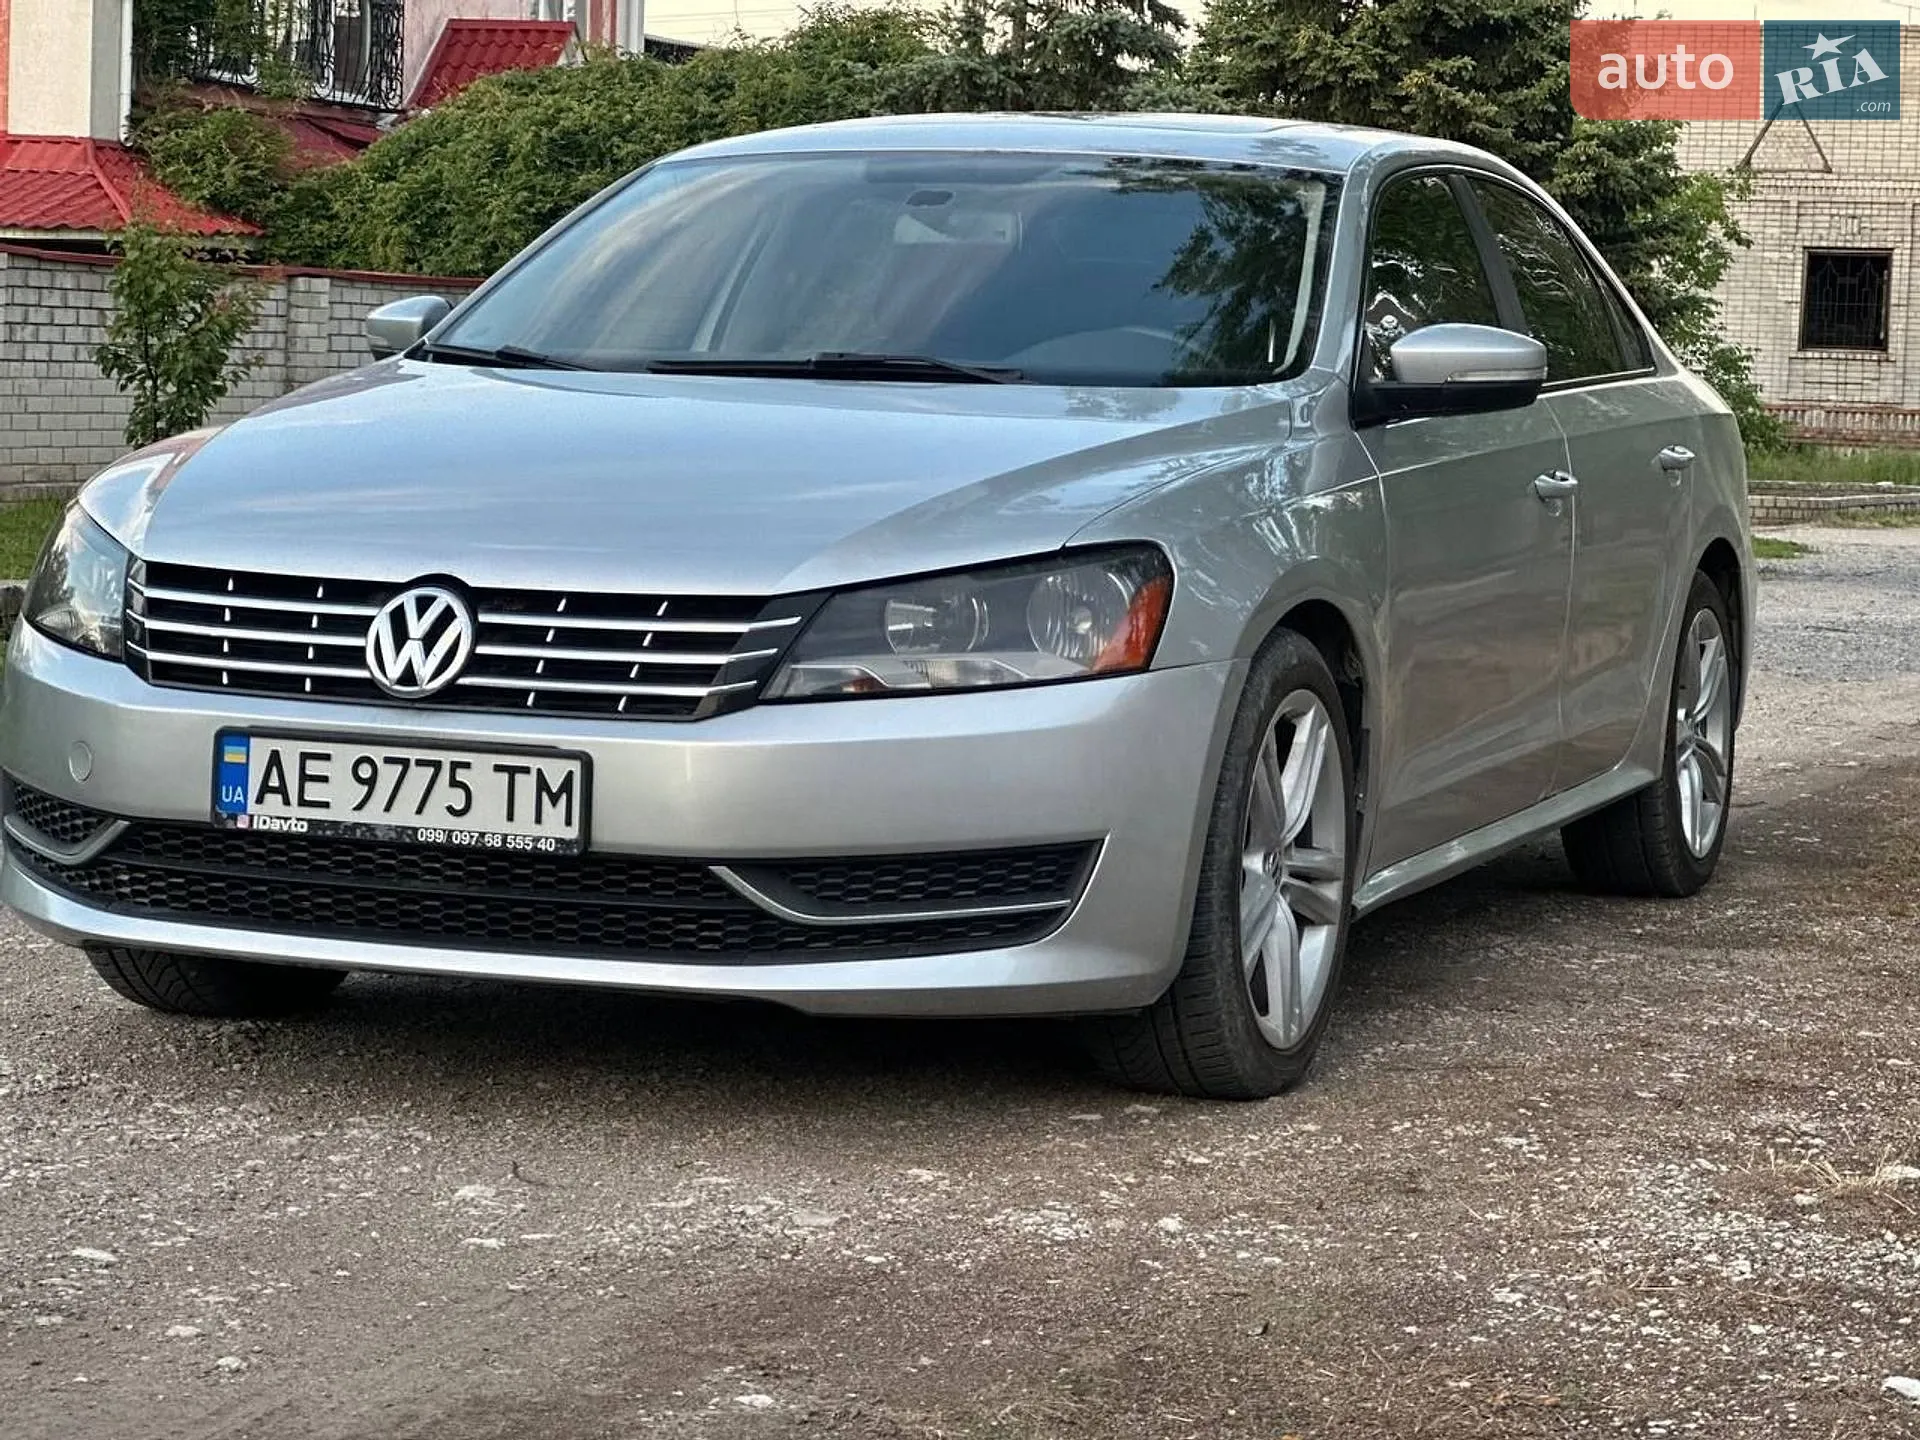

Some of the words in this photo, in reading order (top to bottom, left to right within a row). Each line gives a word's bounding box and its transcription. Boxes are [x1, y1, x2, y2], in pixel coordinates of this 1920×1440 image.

[369, 590, 470, 694] VW
[222, 785, 245, 804] UA
[255, 749, 332, 809] AE
[351, 755, 473, 818] 9775
[493, 763, 575, 827] TM
[417, 828, 448, 843] 099/
[452, 830, 479, 846] 097
[484, 833, 502, 847] 68
[506, 835, 533, 850] 555
[537, 837, 555, 851] 40
